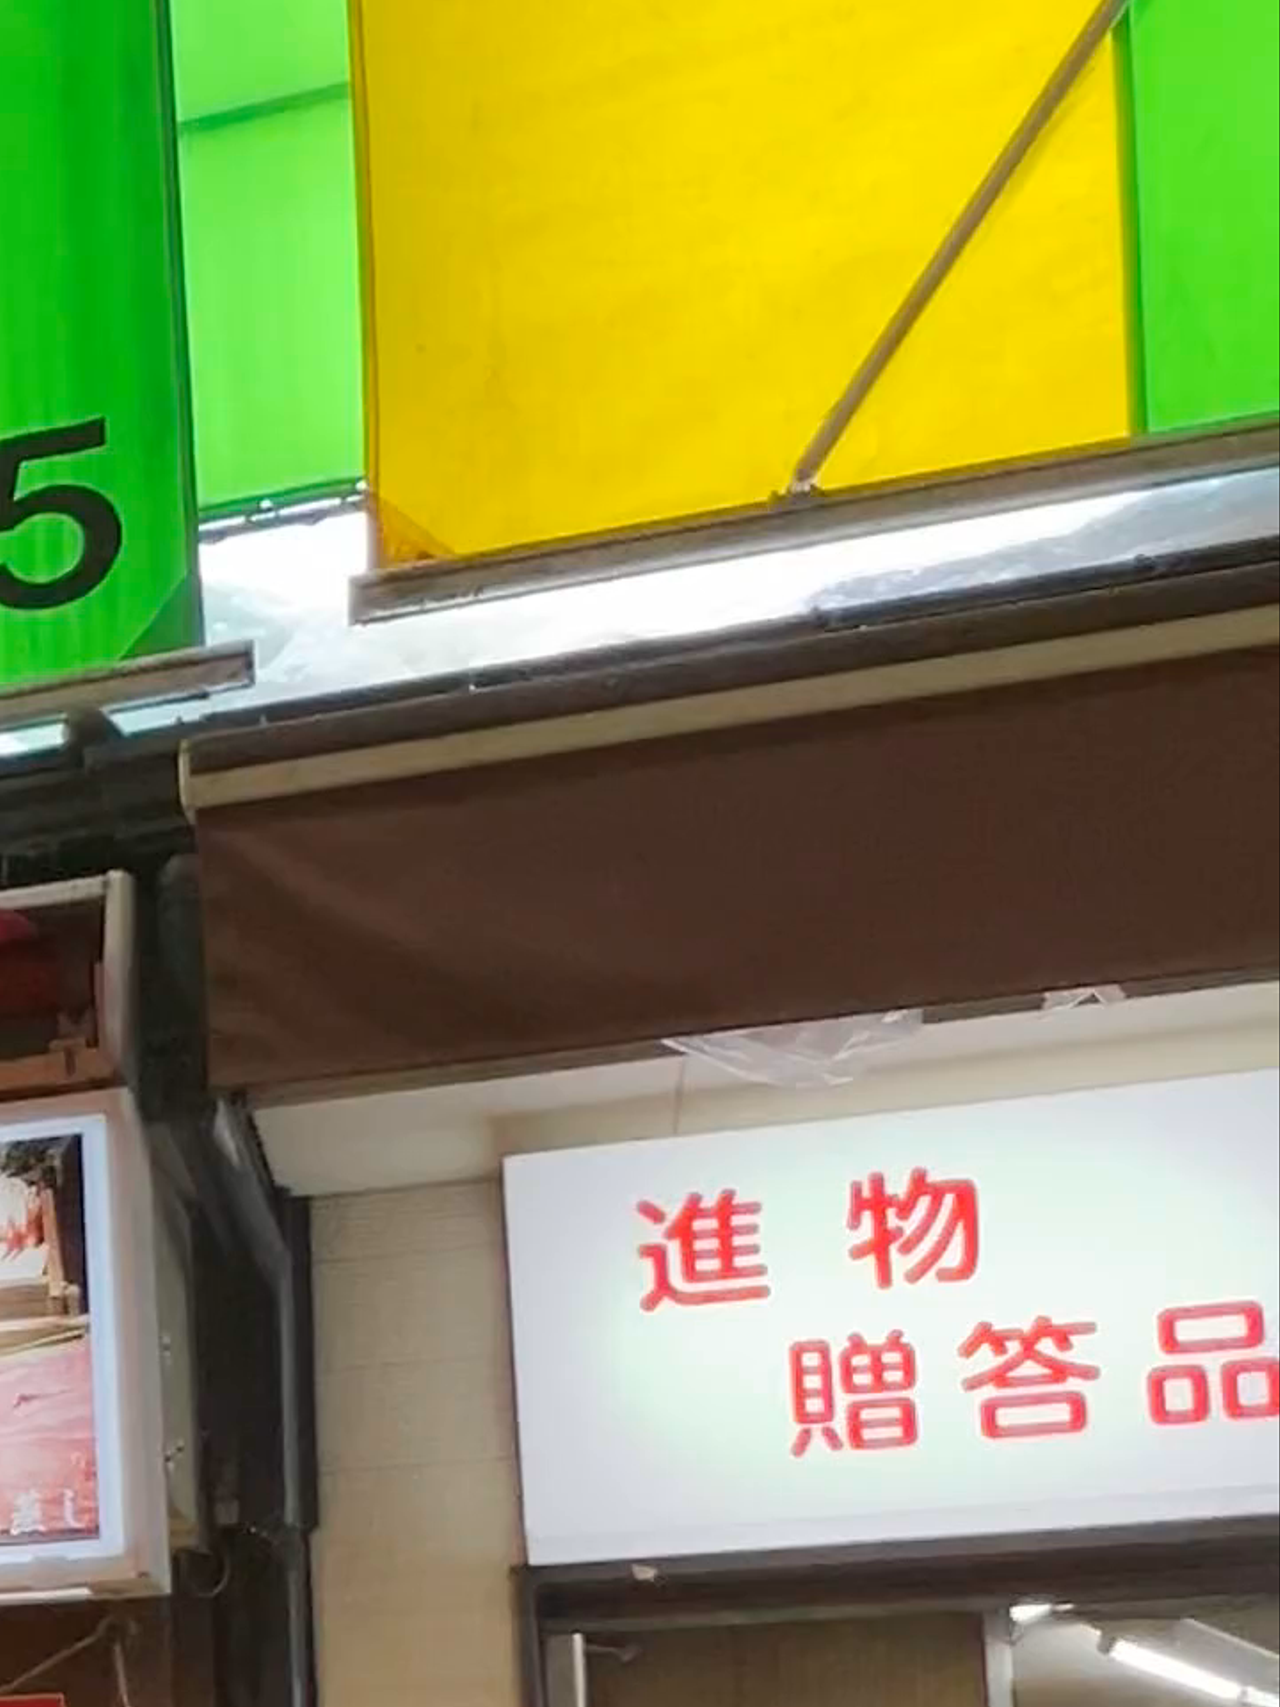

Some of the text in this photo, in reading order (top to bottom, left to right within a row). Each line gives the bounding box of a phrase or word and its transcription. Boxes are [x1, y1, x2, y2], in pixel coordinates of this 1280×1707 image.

[636, 1168, 979, 1312] 進物
[789, 1300, 1280, 1457] 贈答品
